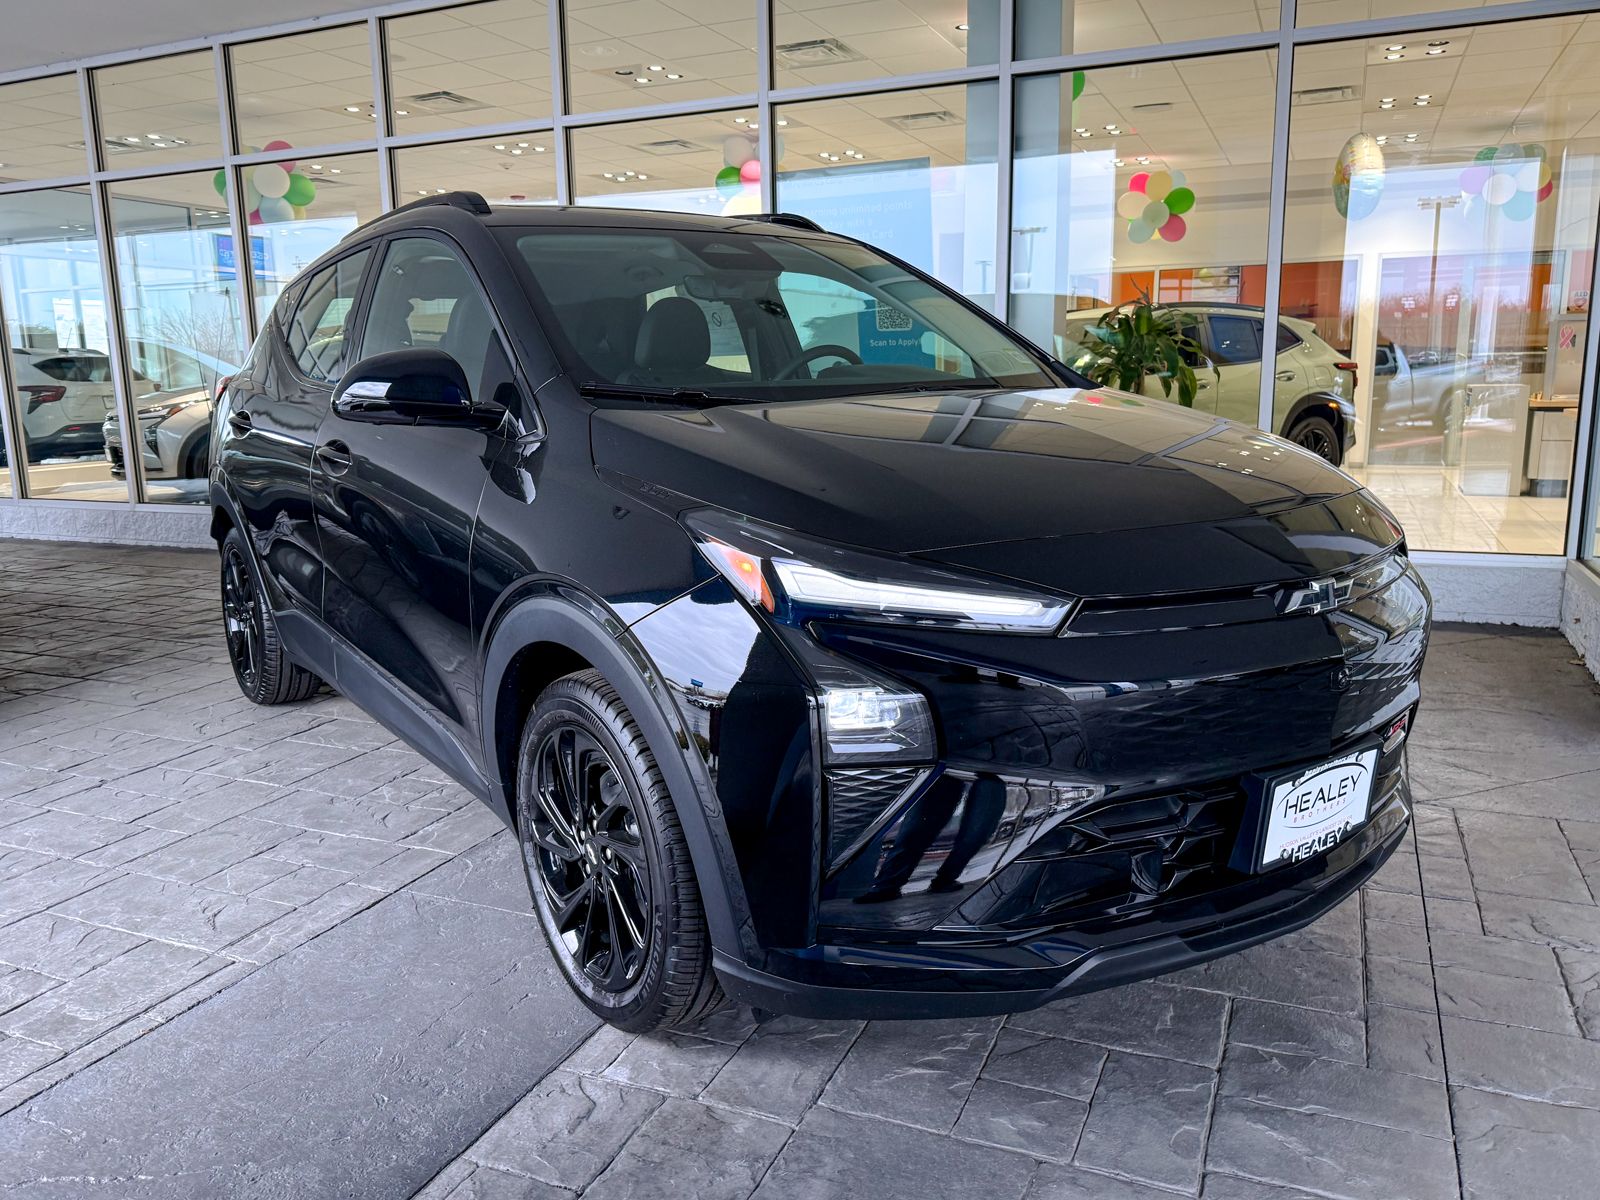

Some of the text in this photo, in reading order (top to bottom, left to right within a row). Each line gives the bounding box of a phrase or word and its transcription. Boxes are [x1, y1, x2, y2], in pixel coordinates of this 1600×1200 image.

[884, 200, 913, 213] points
[869, 338, 887, 347] Scan
[889, 338, 897, 346] to
[1283, 770, 1363, 819] HEALEY
[1293, 797, 1347, 823] BROTHERS
[1291, 826, 1343, 862] HEALEY
